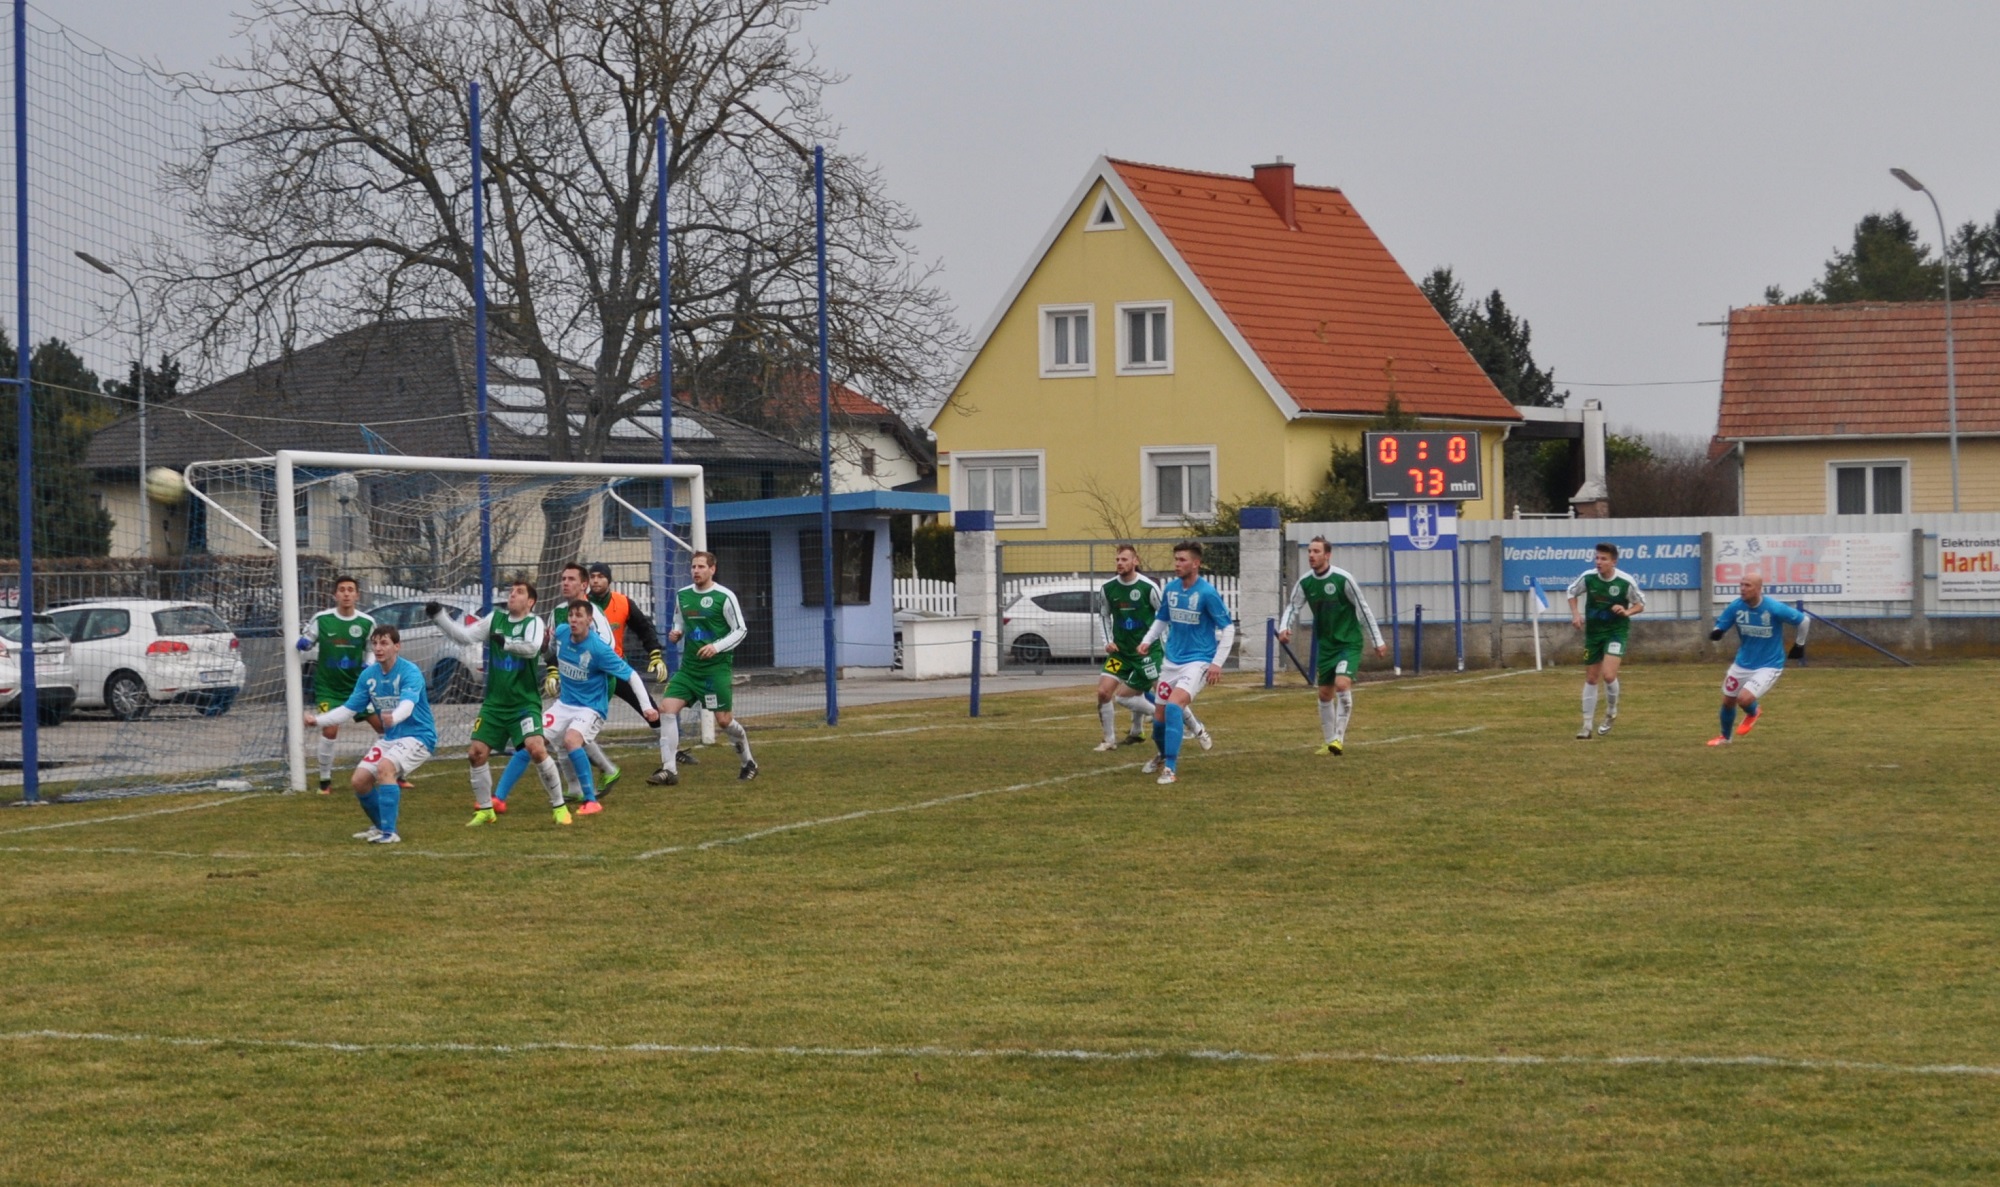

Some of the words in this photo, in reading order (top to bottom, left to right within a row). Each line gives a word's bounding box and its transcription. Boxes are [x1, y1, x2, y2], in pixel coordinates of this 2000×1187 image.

[1379, 436, 1397, 464] 0
[1448, 435, 1466, 463] 0
[1408, 467, 1444, 495] 73
[1450, 480, 1476, 492] min
[1637, 545, 1651, 559] G.
[1942, 551, 1993, 573] Hartl
[1715, 555, 1841, 584] edler
[1658, 573, 1688, 586] 4683
[1775, 585, 1841, 593] POTTENDORF
[1735, 610, 1750, 624] 21
